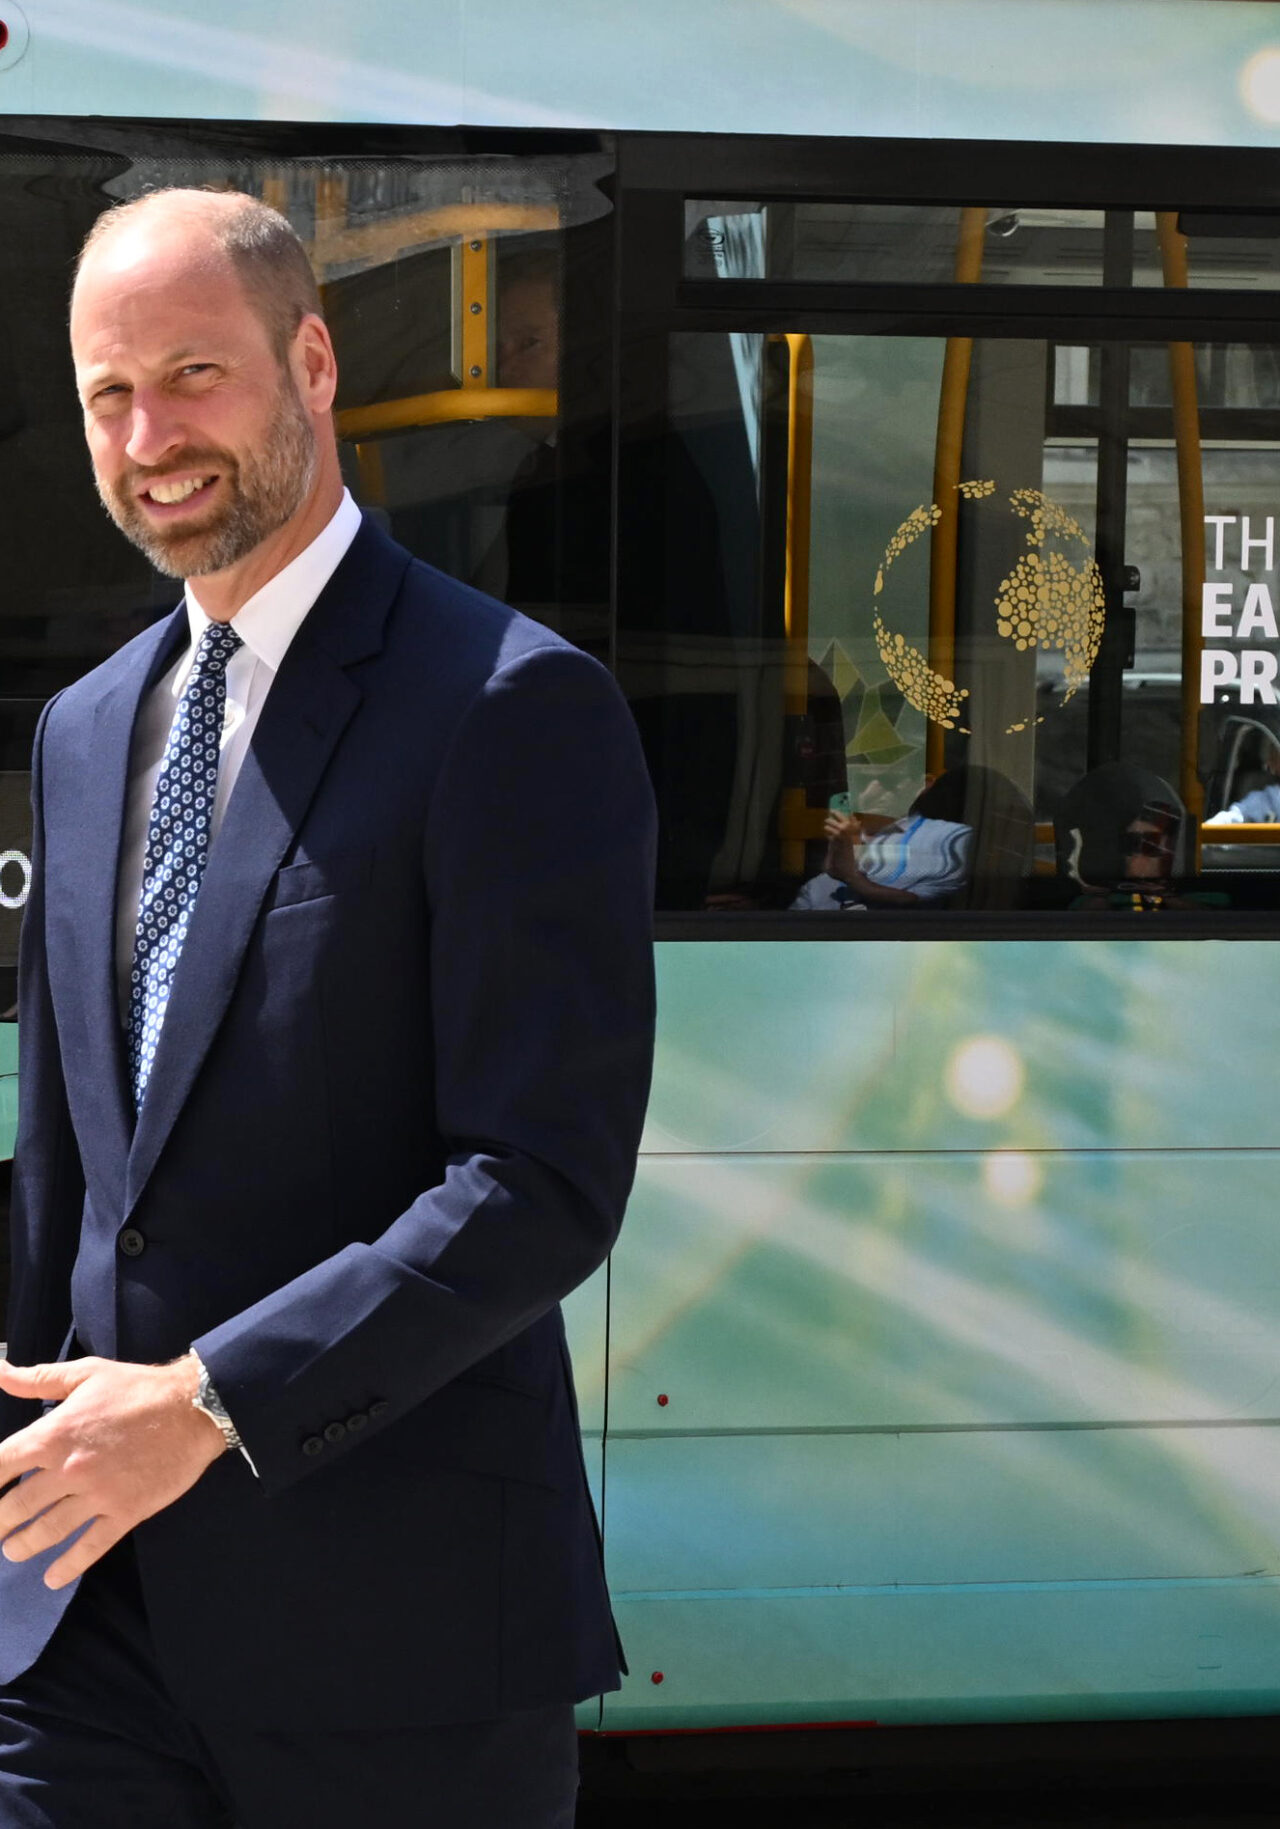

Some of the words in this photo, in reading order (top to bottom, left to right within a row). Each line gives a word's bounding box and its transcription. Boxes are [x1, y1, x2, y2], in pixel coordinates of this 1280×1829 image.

[1203, 515, 1275, 571] TH
[1201, 582, 1280, 638] EA
[1200, 649, 1280, 705] PR
